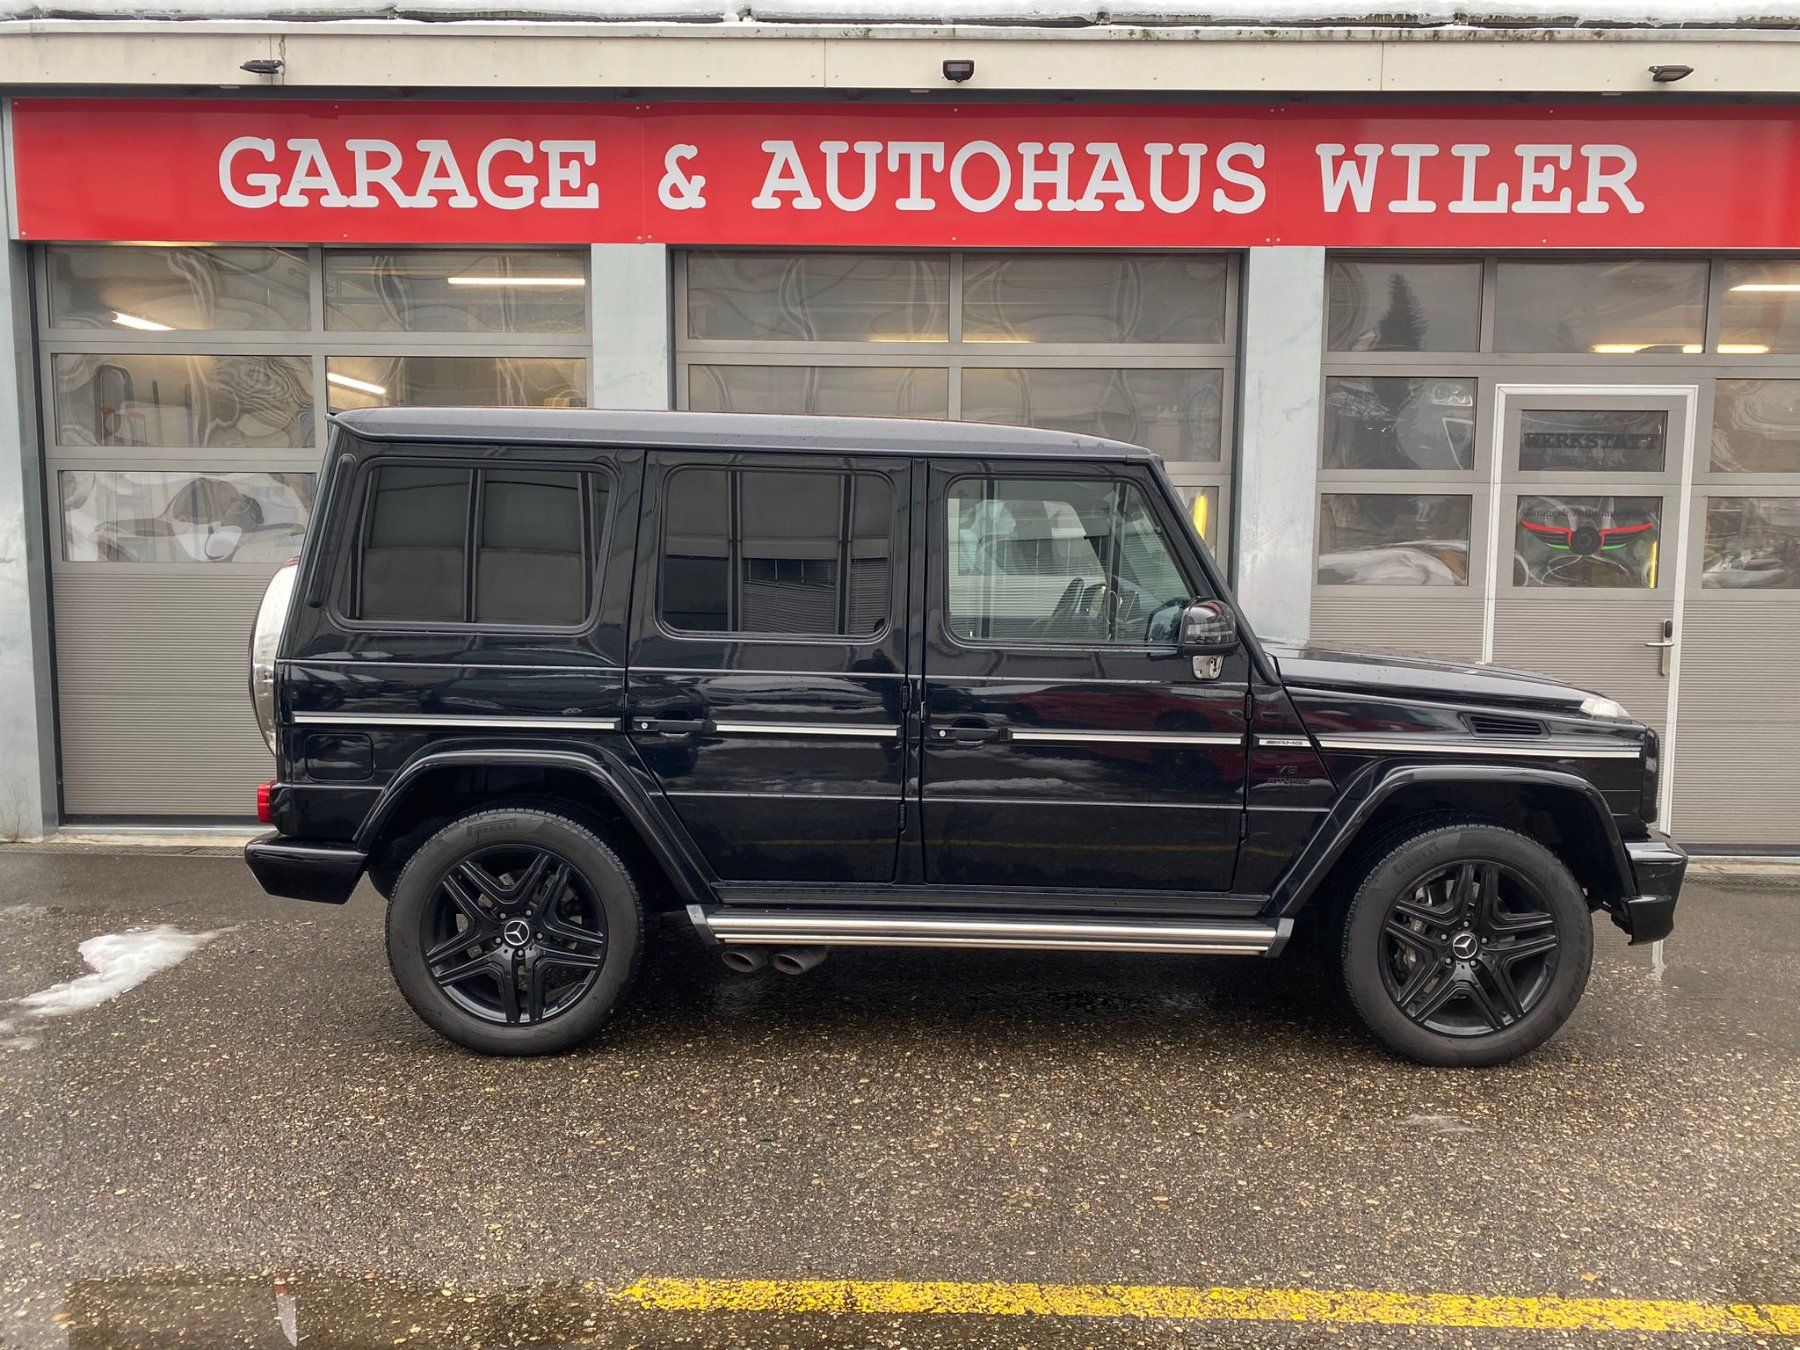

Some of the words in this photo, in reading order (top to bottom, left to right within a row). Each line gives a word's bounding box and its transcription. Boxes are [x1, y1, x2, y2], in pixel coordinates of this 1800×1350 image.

[218, 136, 600, 211] GARAGE
[657, 143, 707, 211] &
[751, 139, 1267, 215] AUTOHAUS
[1314, 142, 1645, 215] WILER
